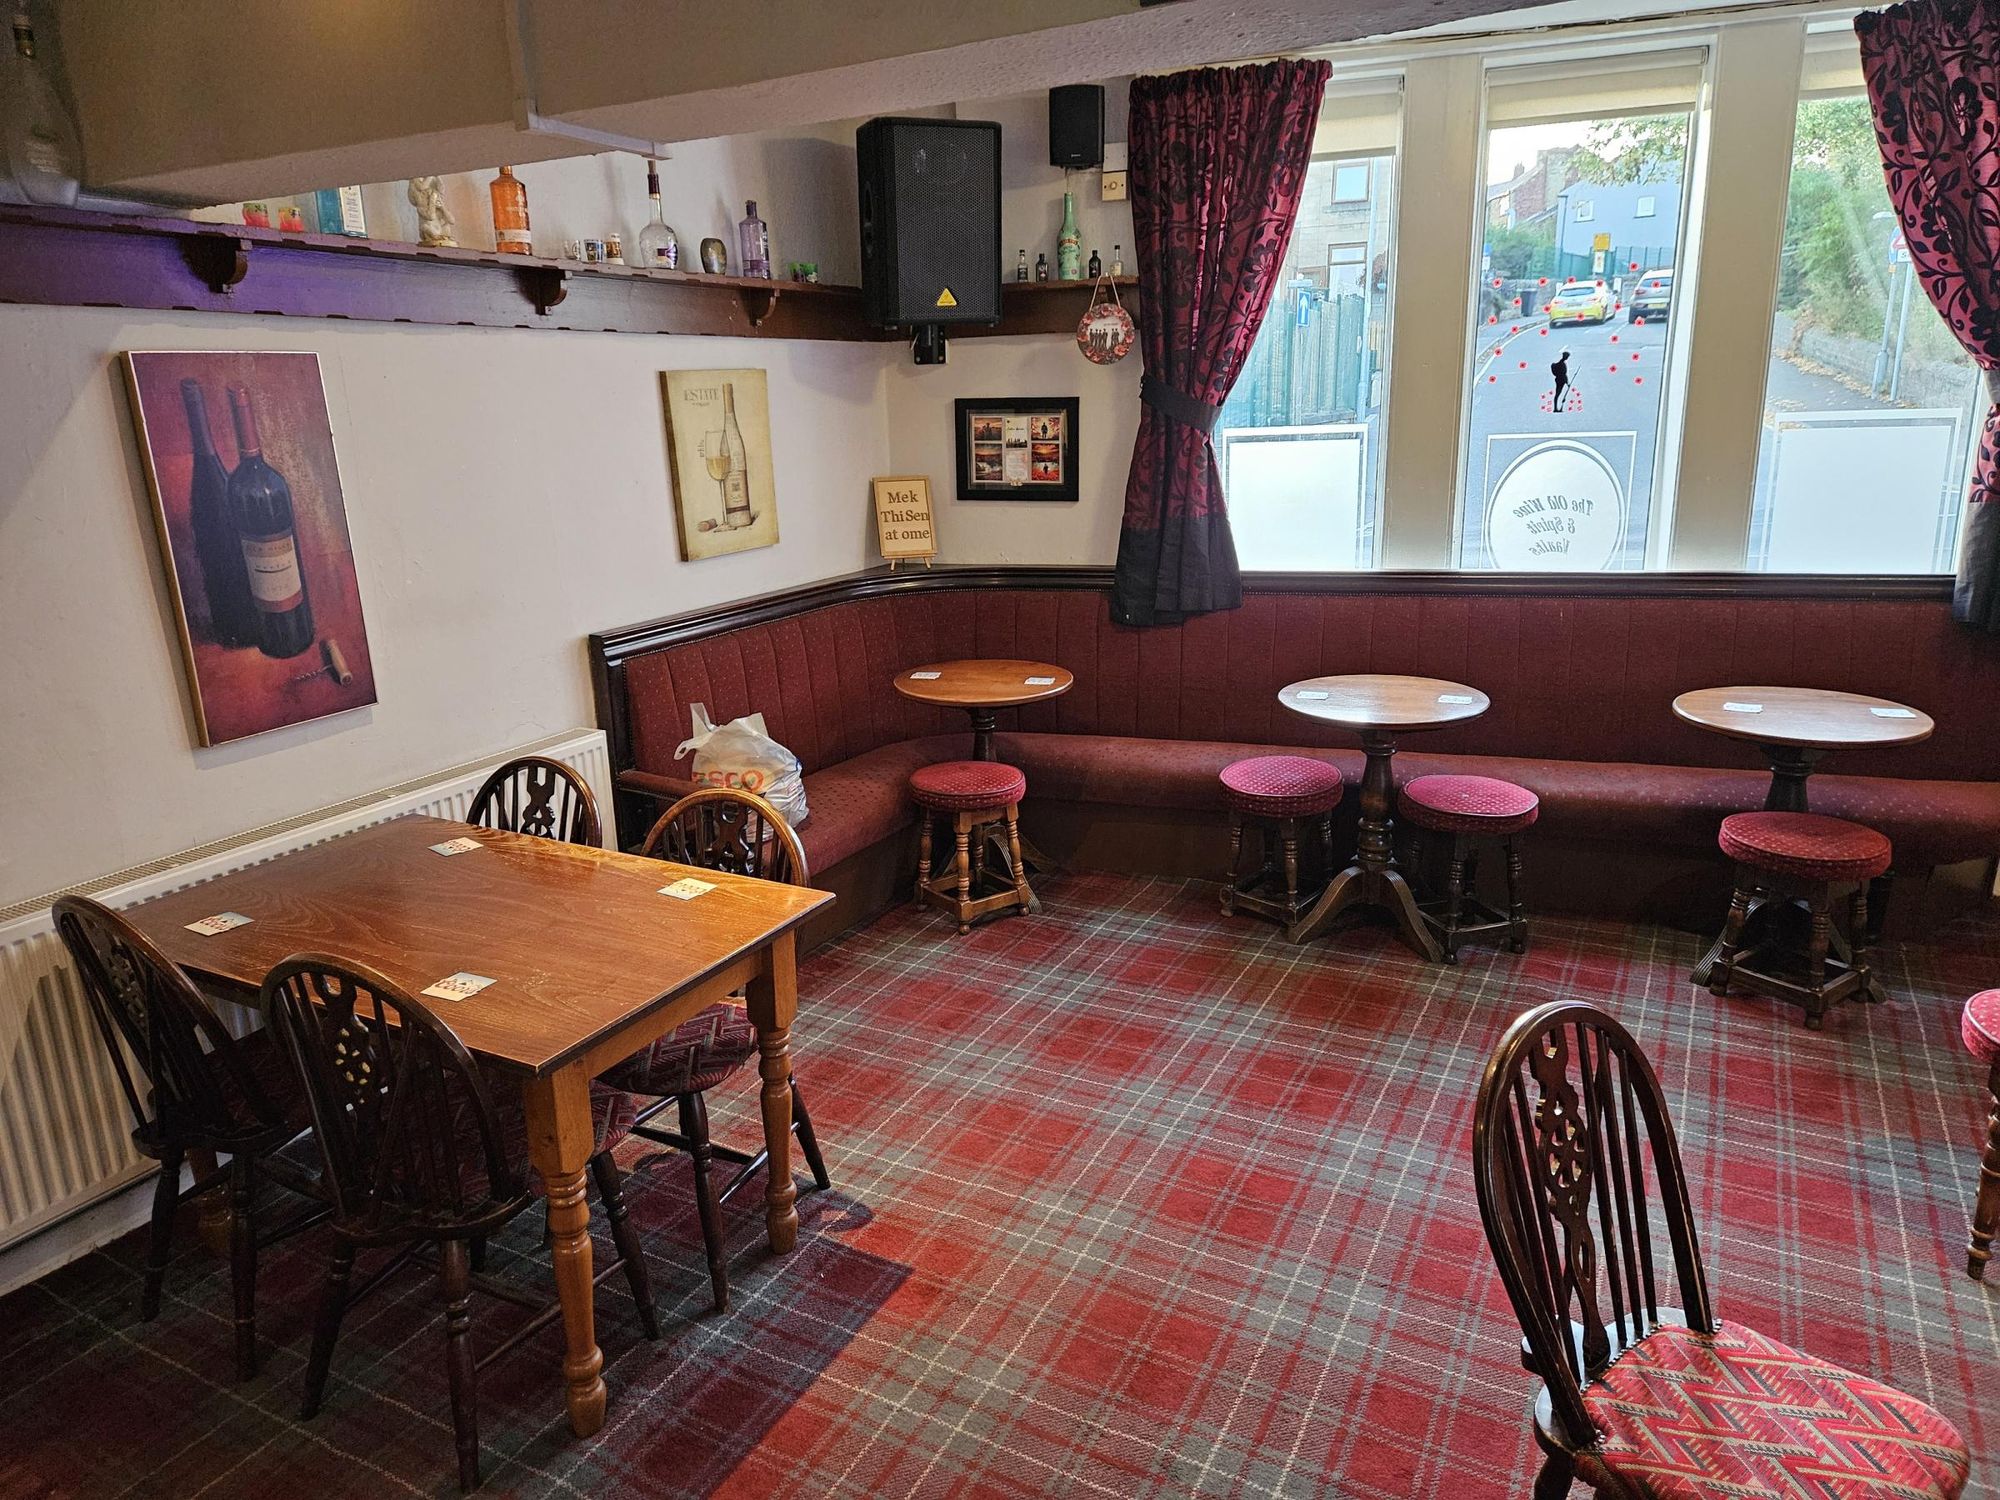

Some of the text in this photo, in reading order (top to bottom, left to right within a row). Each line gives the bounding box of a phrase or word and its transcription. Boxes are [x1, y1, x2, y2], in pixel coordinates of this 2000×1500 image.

[887, 490, 919, 503] Mek
[885, 529, 930, 541] at ome
